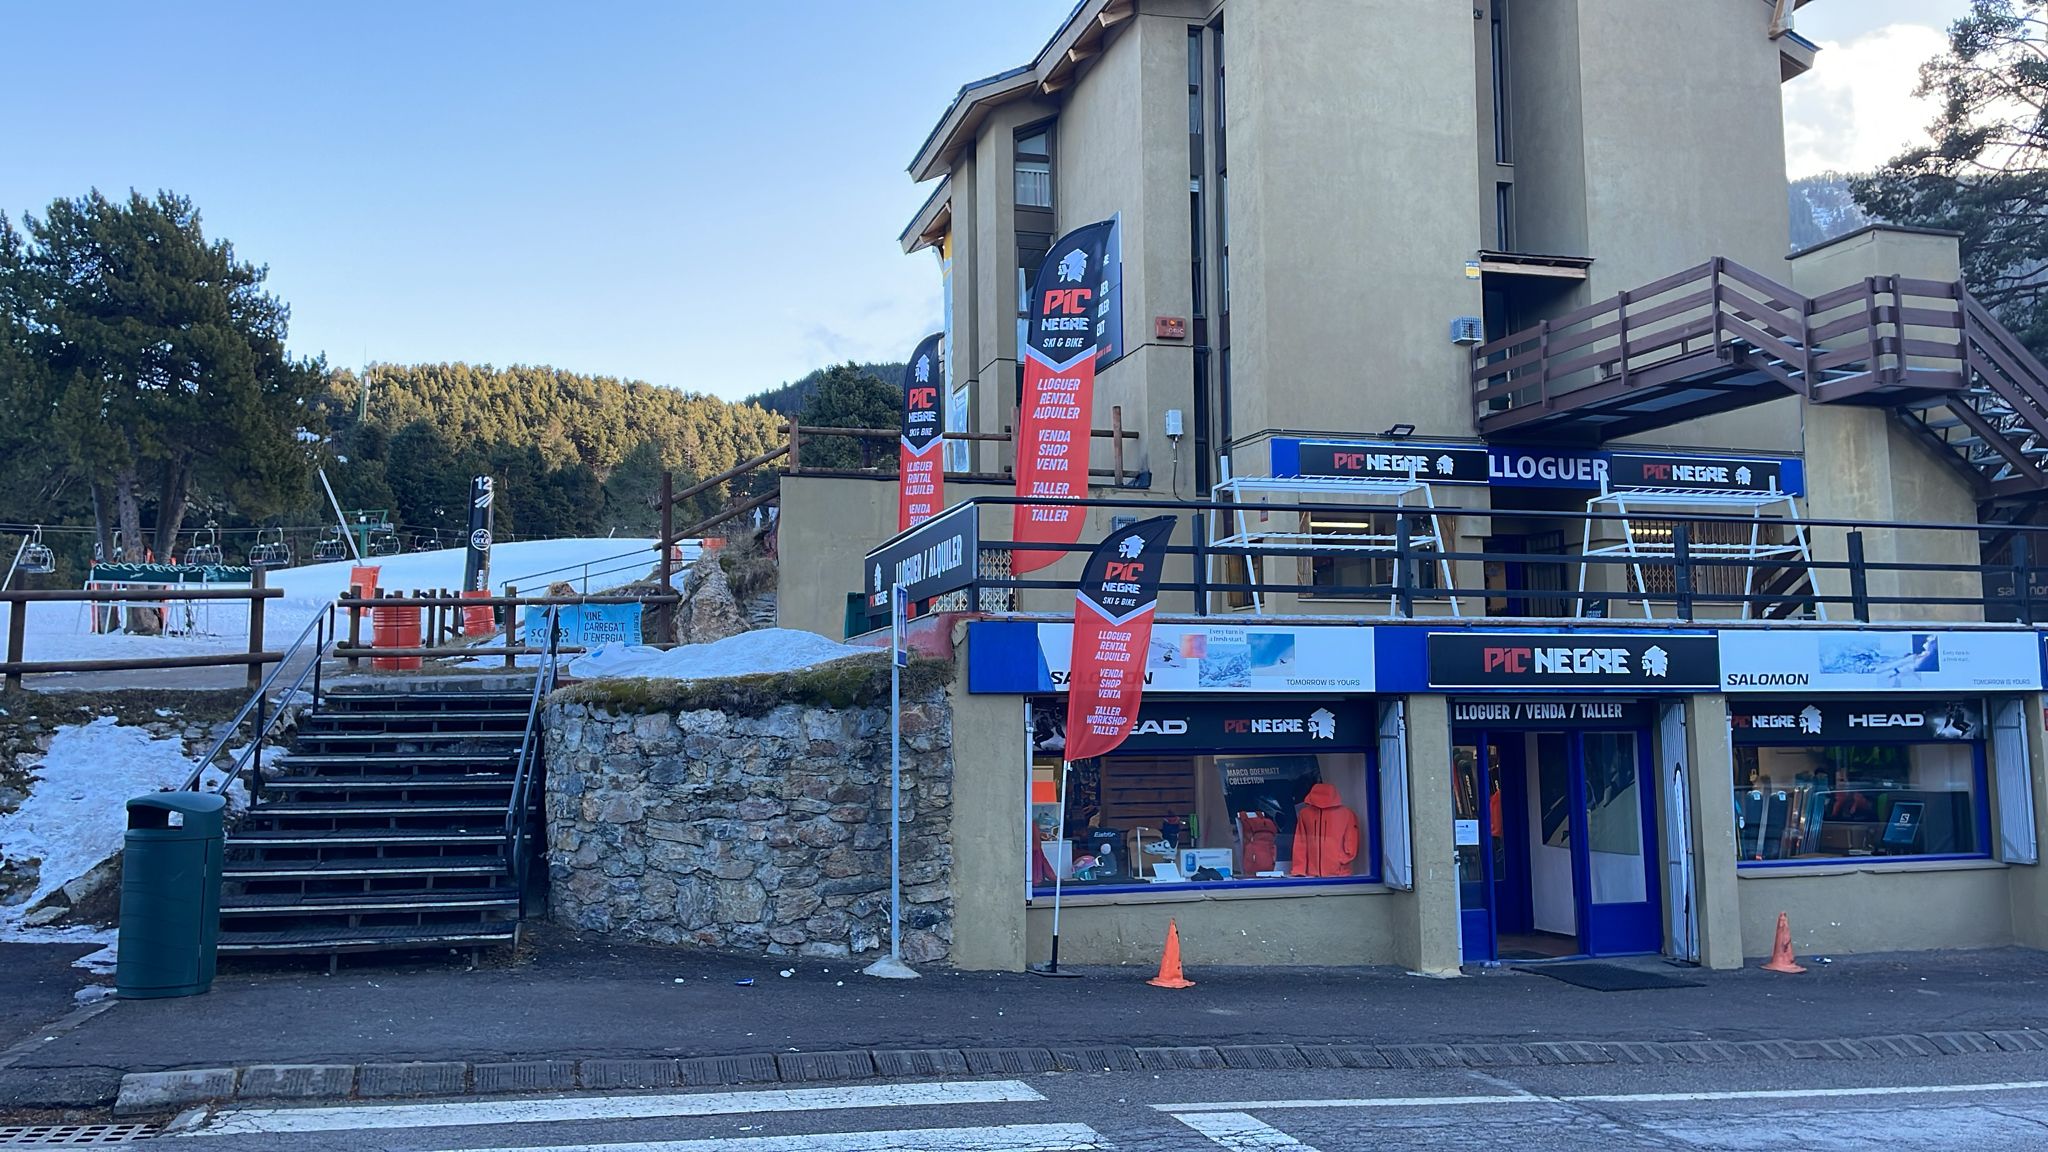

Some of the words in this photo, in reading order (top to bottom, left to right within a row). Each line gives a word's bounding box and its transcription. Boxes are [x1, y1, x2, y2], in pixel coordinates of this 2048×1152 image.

[1041, 317, 1090, 331] NEGRE
[1042, 338, 1056, 348] SKI
[1056, 338, 1063, 347] &
[1064, 338, 1084, 348] BIKE
[1037, 378, 1081, 391] LLOGUER
[1039, 392, 1076, 405] RENTAL
[908, 411, 937, 423] NEGRE
[1033, 406, 1080, 420] ALQUILER
[1038, 429, 1071, 442] VENDA
[1038, 444, 1068, 456] SHOP
[1036, 458, 1069, 471] VENTA
[1366, 454, 1429, 473] NEGRE
[1488, 454, 1610, 481] LLOGUER
[1672, 465, 1729, 483] NEGRE
[475, 476, 493, 491] 12
[1032, 482, 1070, 495] TALLER
[1031, 509, 1069, 522] TALLER
[928, 534, 962, 579] ALQUILER
[1101, 582, 1141, 594] NEGRE
[1102, 596, 1114, 605] SKI
[1120, 598, 1137, 607] BIKE
[1098, 630, 1132, 642] LLOGUER
[1099, 641, 1127, 652] RENTAL
[1094, 651, 1130, 662] ALQUILER
[1534, 648, 1630, 674] NEGRE
[1099, 668, 1124, 679] VENDA
[1727, 673, 1809, 686] SALOMON
[1100, 679, 1122, 689] SHOP
[1098, 688, 1121, 699] VENTA
[1095, 706, 1121, 716] TALLER
[1455, 704, 1511, 720] LLOGUER
[1514, 704, 1521, 720] /
[1526, 704, 1567, 720] VENDA
[1570, 704, 1576, 719] /
[1580, 704, 1623, 719] TALLER
[1086, 715, 1127, 726] WORKSHOP
[1251, 719, 1303, 733] NEGRE
[1752, 715, 1796, 728] NEGRE
[1848, 713, 1925, 727] HEAD
[1092, 725, 1119, 736] TALLER
[1226, 768, 1249, 777] MARCO
[1228, 776, 1265, 786] COLLECTION
